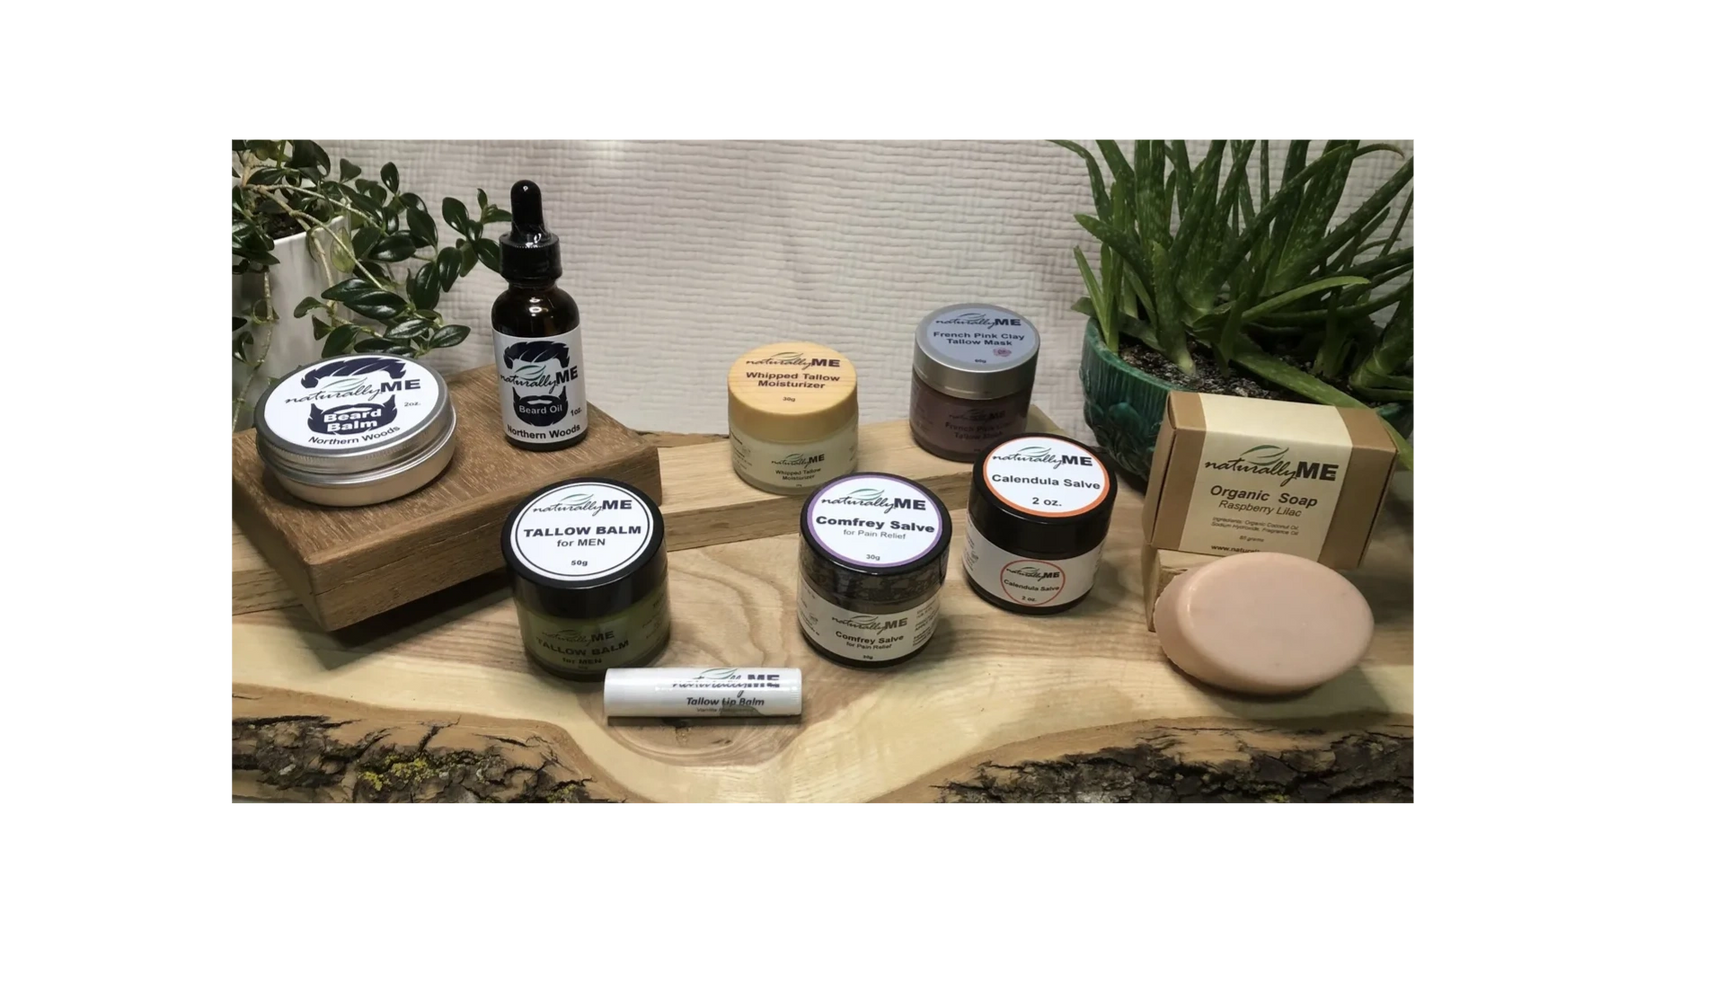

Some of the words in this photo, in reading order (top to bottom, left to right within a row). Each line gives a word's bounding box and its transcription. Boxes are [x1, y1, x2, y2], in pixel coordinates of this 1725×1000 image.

[936, 318, 1021, 329] naturallyME
[746, 358, 840, 370] naturallyME
[500, 366, 578, 394] naturallyME
[746, 372, 798, 380] Whipped
[803, 374, 840, 382] Tallow
[758, 380, 825, 388] Moisturizer
[285, 379, 421, 404] naturallyME
[324, 409, 382, 423] Beard
[518, 405, 546, 414] Beard
[550, 404, 562, 413] Oil
[327, 419, 378, 432] Balm
[507, 424, 546, 439] Northern
[549, 424, 580, 438] Woods
[308, 436, 359, 445] Northern
[362, 426, 400, 442] Woods
[992, 453, 1093, 469] naturallyME
[1205, 458, 1338, 487] naturallyME
[992, 474, 1059, 486] Calendula
[1064, 479, 1100, 490] Salve
[1210, 485, 1270, 501] Organic
[1278, 493, 1318, 508] Soap
[533, 500, 632, 516] naturallyME
[822, 496, 926, 514] naturallyME
[1219, 500, 1274, 515] Raspberry
[1276, 506, 1302, 518] Lilac
[816, 516, 885, 530] Comfrey
[890, 521, 935, 532] Salve
[524, 526, 591, 537] TALLOW
[596, 526, 642, 534] BALM
[880, 532, 906, 540] Relief
[578, 538, 606, 546] MEN
[1004, 580, 1039, 591] Calendula
[836, 630, 875, 644] Comfrey
[878, 635, 904, 644] Salve
[536, 637, 586, 656] TALLOW
[592, 640, 629, 656] BALM
[687, 698, 719, 706] Tallow
[722, 697, 736, 707] Lip
[740, 698, 764, 706] Balm
